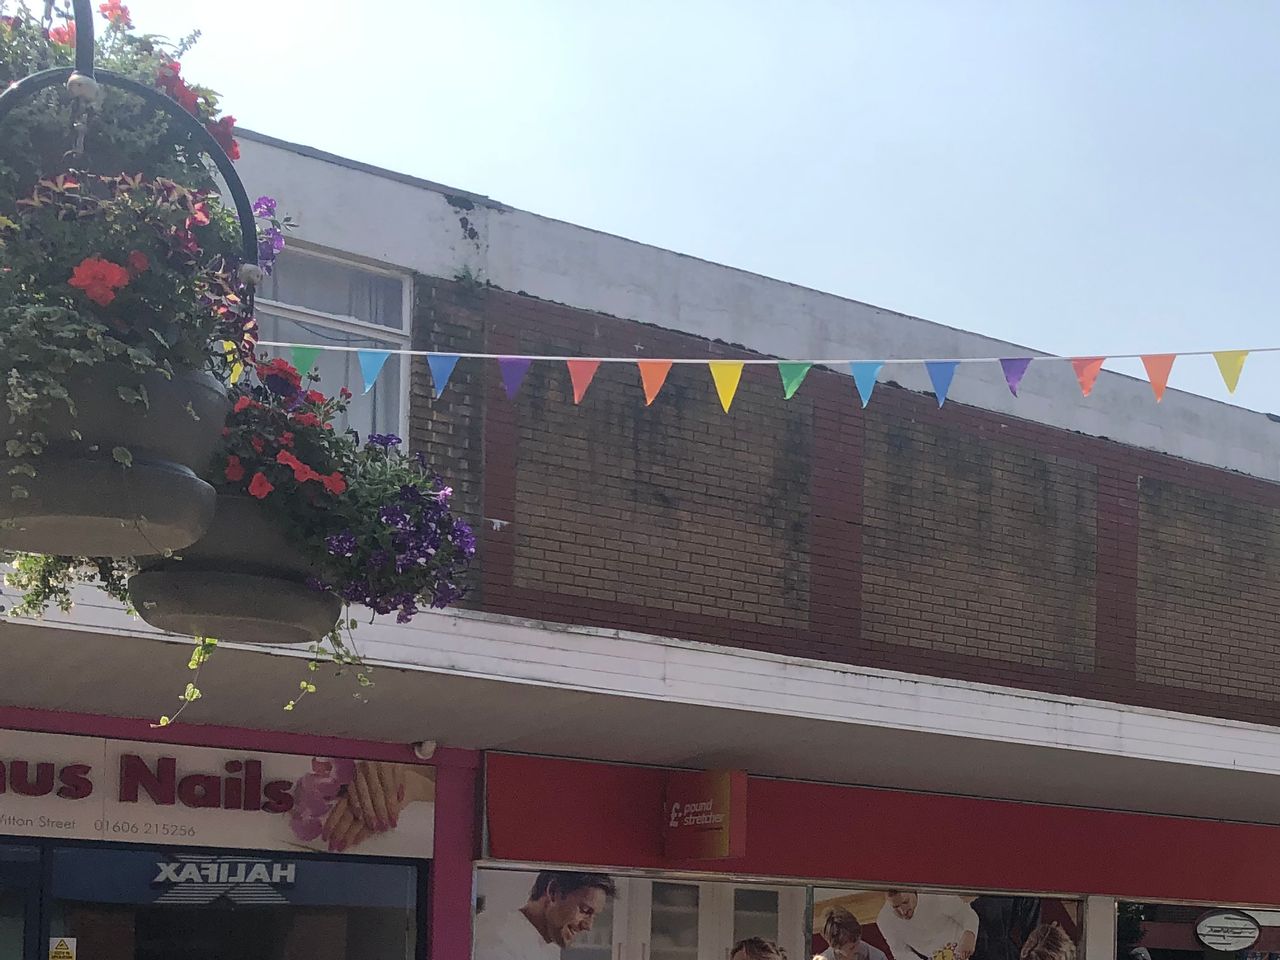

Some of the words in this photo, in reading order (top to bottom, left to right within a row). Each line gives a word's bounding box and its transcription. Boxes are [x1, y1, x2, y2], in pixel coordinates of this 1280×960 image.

[119, 754, 294, 813] Nails
[684, 799, 713, 815] pound
[39, 816, 76, 829] Street
[94, 820, 139, 834] 01606
[143, 822, 196, 837] 215256
[683, 813, 725, 825] stretcher
